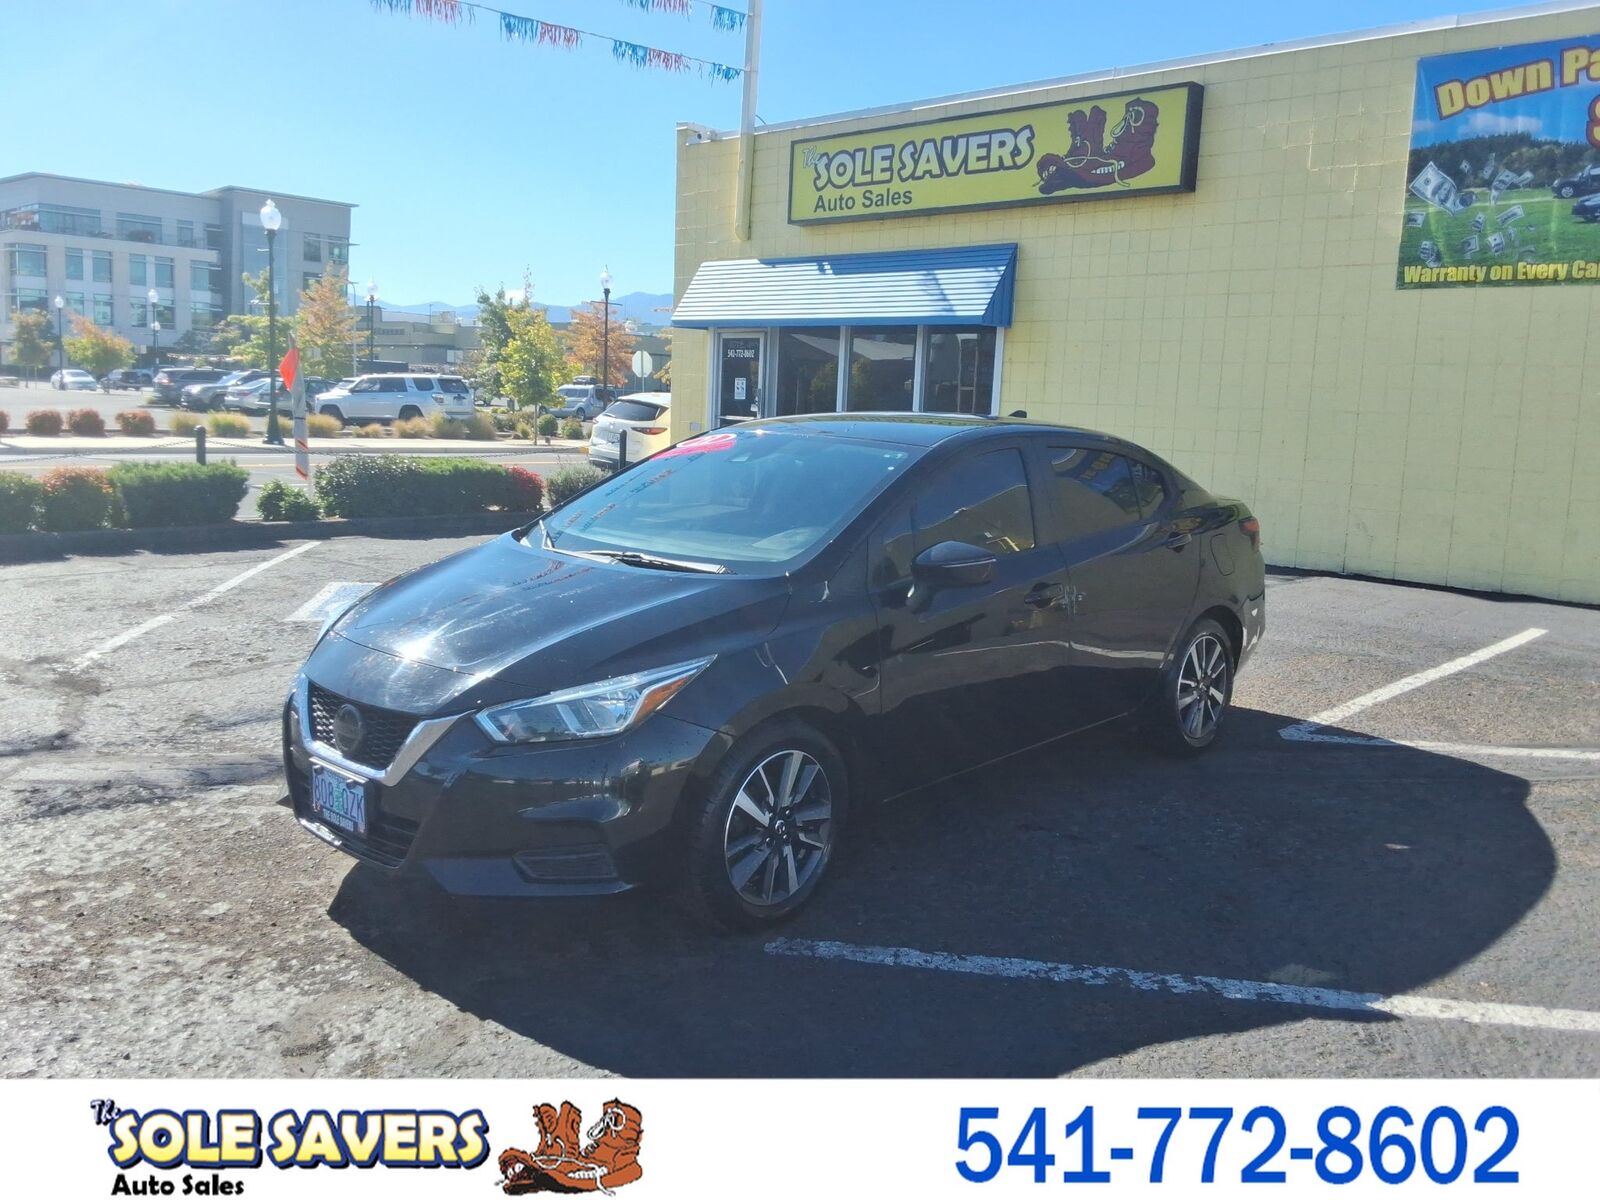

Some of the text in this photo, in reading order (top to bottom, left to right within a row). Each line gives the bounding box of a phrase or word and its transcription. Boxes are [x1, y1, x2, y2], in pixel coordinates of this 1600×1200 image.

[1434, 60, 1554, 120] Down
[813, 144, 895, 191] SOLE
[897, 125, 1035, 182] SAVERS
[814, 188, 912, 213] Auto Sales
[1404, 265, 1487, 283] Warranty
[1490, 265, 1513, 280] on
[1517, 262, 1569, 280] Every
